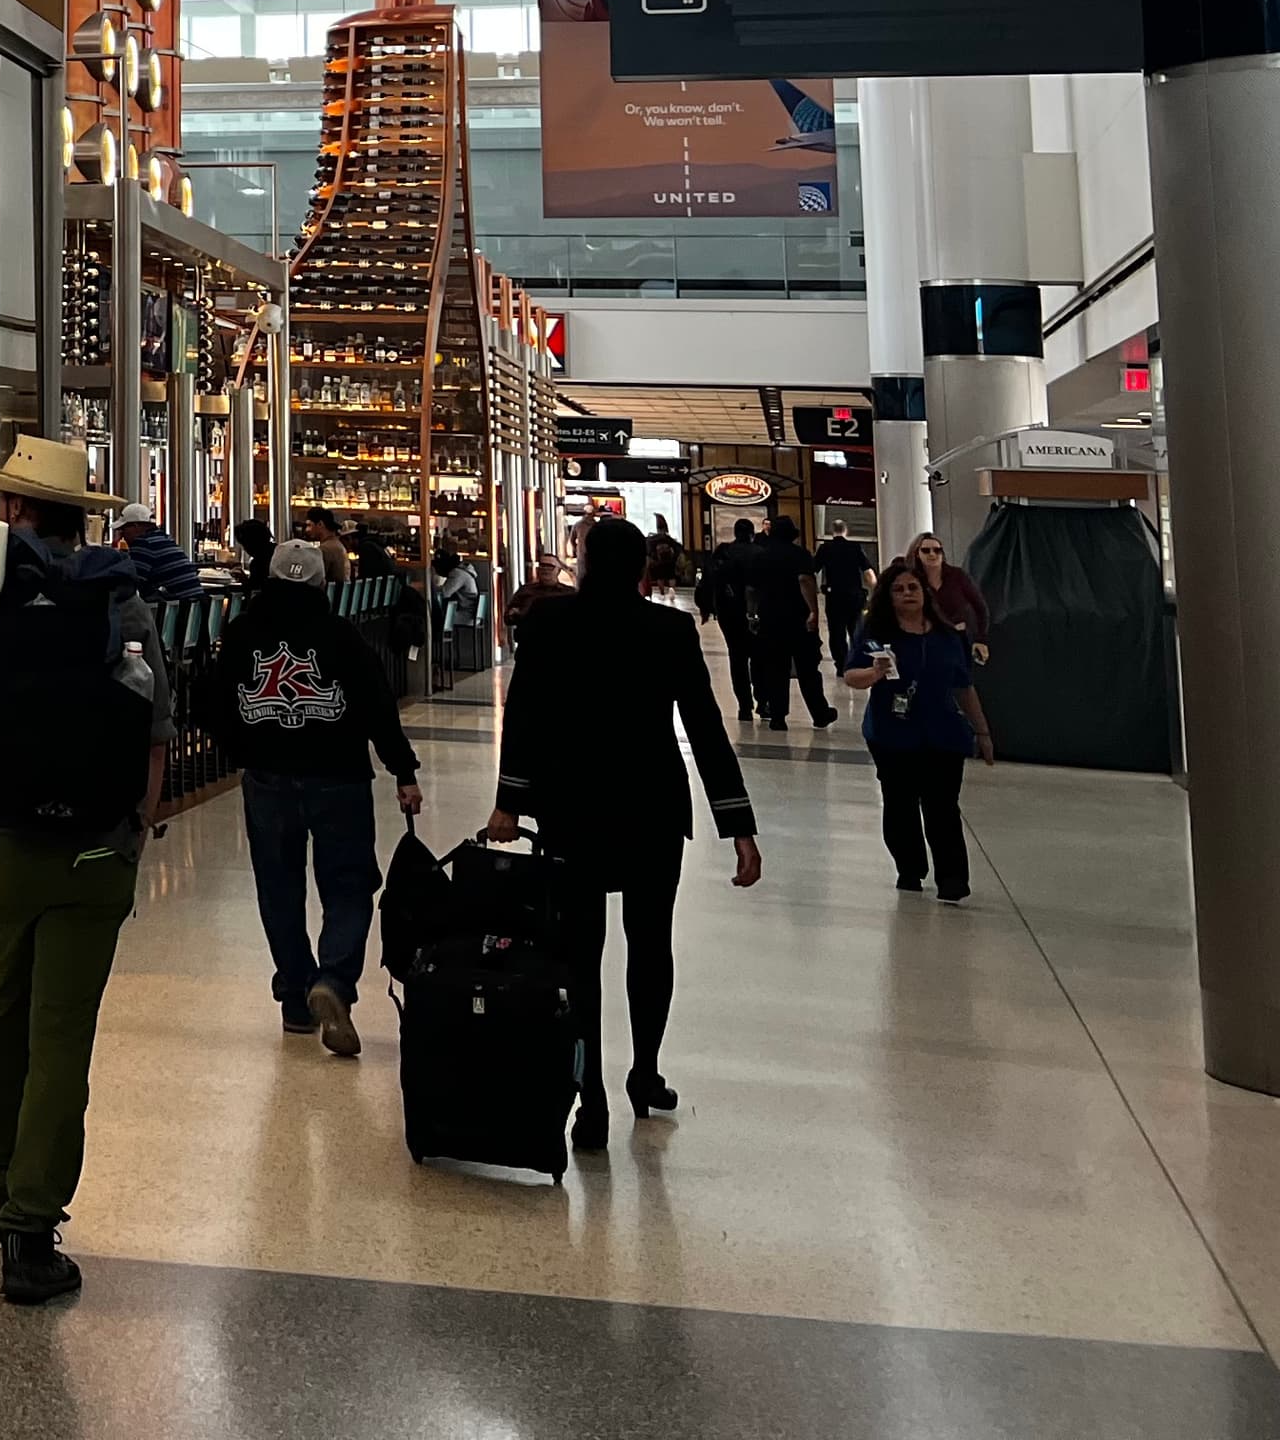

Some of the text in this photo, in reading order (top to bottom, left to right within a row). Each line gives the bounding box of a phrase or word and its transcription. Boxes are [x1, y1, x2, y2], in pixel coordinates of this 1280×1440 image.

[624, 104, 643, 115] Or,
[645, 105, 668, 116] you
[669, 103, 706, 115] know,
[644, 115, 725, 126] We won't tell.
[653, 192, 736, 204] UNITED
[826, 417, 860, 437] E2
[1026, 445, 1107, 457] AMERICANA
[711, 476, 767, 497] PAPPADEAUX
[246, 650, 334, 703] K
